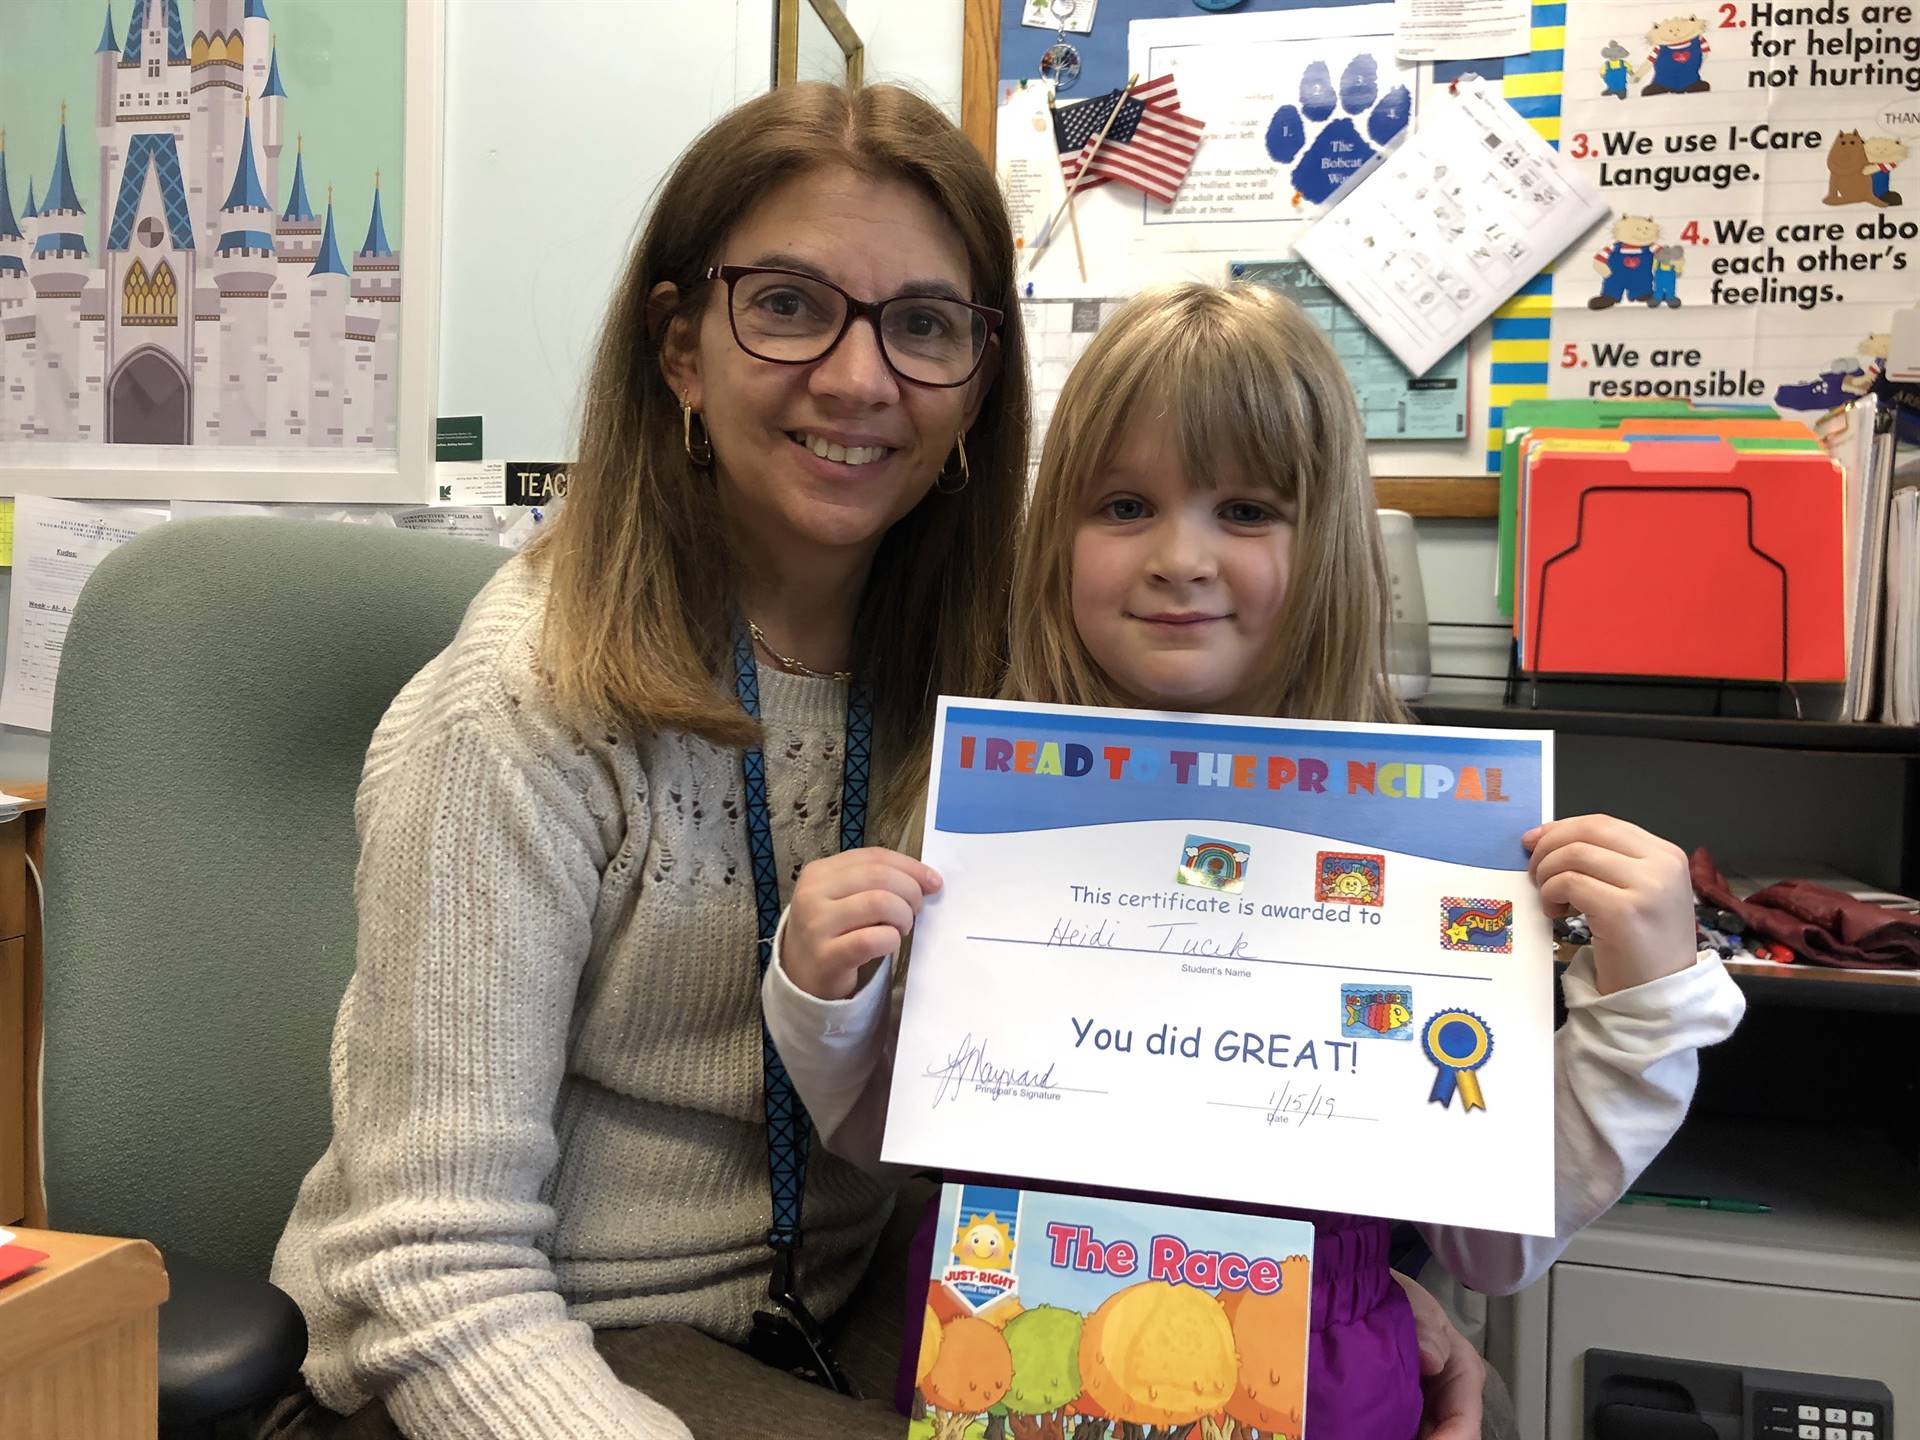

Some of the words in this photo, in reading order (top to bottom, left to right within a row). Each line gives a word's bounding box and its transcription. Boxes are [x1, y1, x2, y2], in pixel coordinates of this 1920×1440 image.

[1718, 3, 1747, 28] 2.
[1751, 0, 1849, 27] Hands
[1861, 6, 1912, 24] are
[1751, 30, 1796, 57] for
[1807, 28, 1920, 62] helping
[1748, 64, 1798, 88] not
[1810, 59, 1920, 92] hurting
[1330, 141, 1354, 153] The
[1570, 134, 1598, 158] 3.
[1602, 131, 1654, 156] We
[1665, 134, 1717, 153] use
[1729, 126, 1822, 151] I-Care
[1321, 157, 1361, 169] Bobcat
[1600, 163, 1760, 191] Language.
[1680, 221, 1710, 245] 4.
[1713, 220, 1764, 244] We
[1776, 223, 1844, 243] care
[1855, 214, 1919, 240] abo
[1712, 247, 1785, 275] each
[1797, 246, 1907, 272] other's
[1711, 278, 1844, 309] feelings.
[1561, 344, 1588, 368] 5.
[1592, 343, 1639, 367] We
[1650, 349, 1701, 367] are
[1589, 371, 1765, 397] responsible
[960, 736, 976, 768] I
[985, 737, 1094, 778] READ
[1103, 746, 1162, 784] TO
[1170, 750, 1257, 788] THE
[1267, 755, 1510, 802] PRINCIPAL
[1070, 885, 1111, 905] This
[1118, 890, 1230, 915] certificate
[1238, 898, 1254, 916] is
[1261, 902, 1350, 923] awarded
[1360, 907, 1382, 925] to
[1048, 917, 1121, 948] Heidi
[1181, 963, 1223, 976] Student's
[1225, 968, 1252, 978] Name
[1072, 1017, 1133, 1052] You
[1146, 1024, 1201, 1058] did
[1215, 1030, 1357, 1074] GREAT!
[974, 1083, 1018, 1096] Principal's
[1020, 1088, 1062, 1101] Signature
[1267, 1112, 1289, 1124] Date
[1048, 1221, 1136, 1276] The
[1150, 1236, 1282, 1294] Race
[945, 1270, 1016, 1290] JUST-RIGHT
